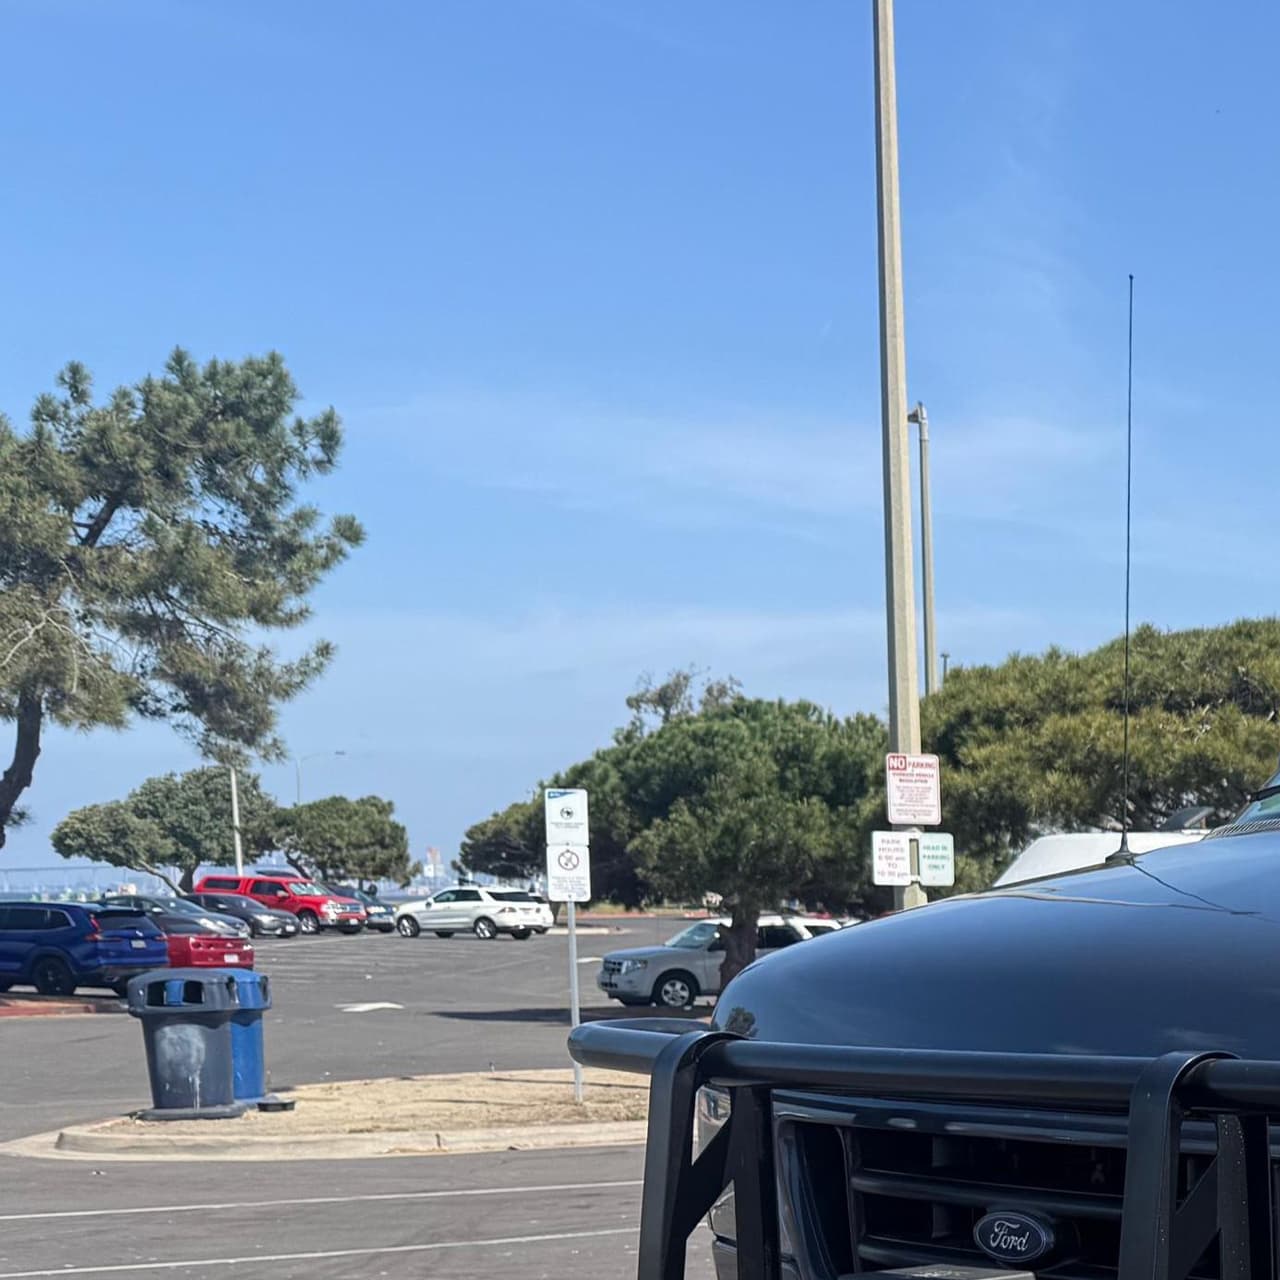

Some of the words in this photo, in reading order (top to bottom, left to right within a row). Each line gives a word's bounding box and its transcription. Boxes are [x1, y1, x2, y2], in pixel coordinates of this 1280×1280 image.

[888, 756, 905, 770] NO
[908, 761, 936, 769] PARKING
[990, 1220, 1029, 1251] Ford
